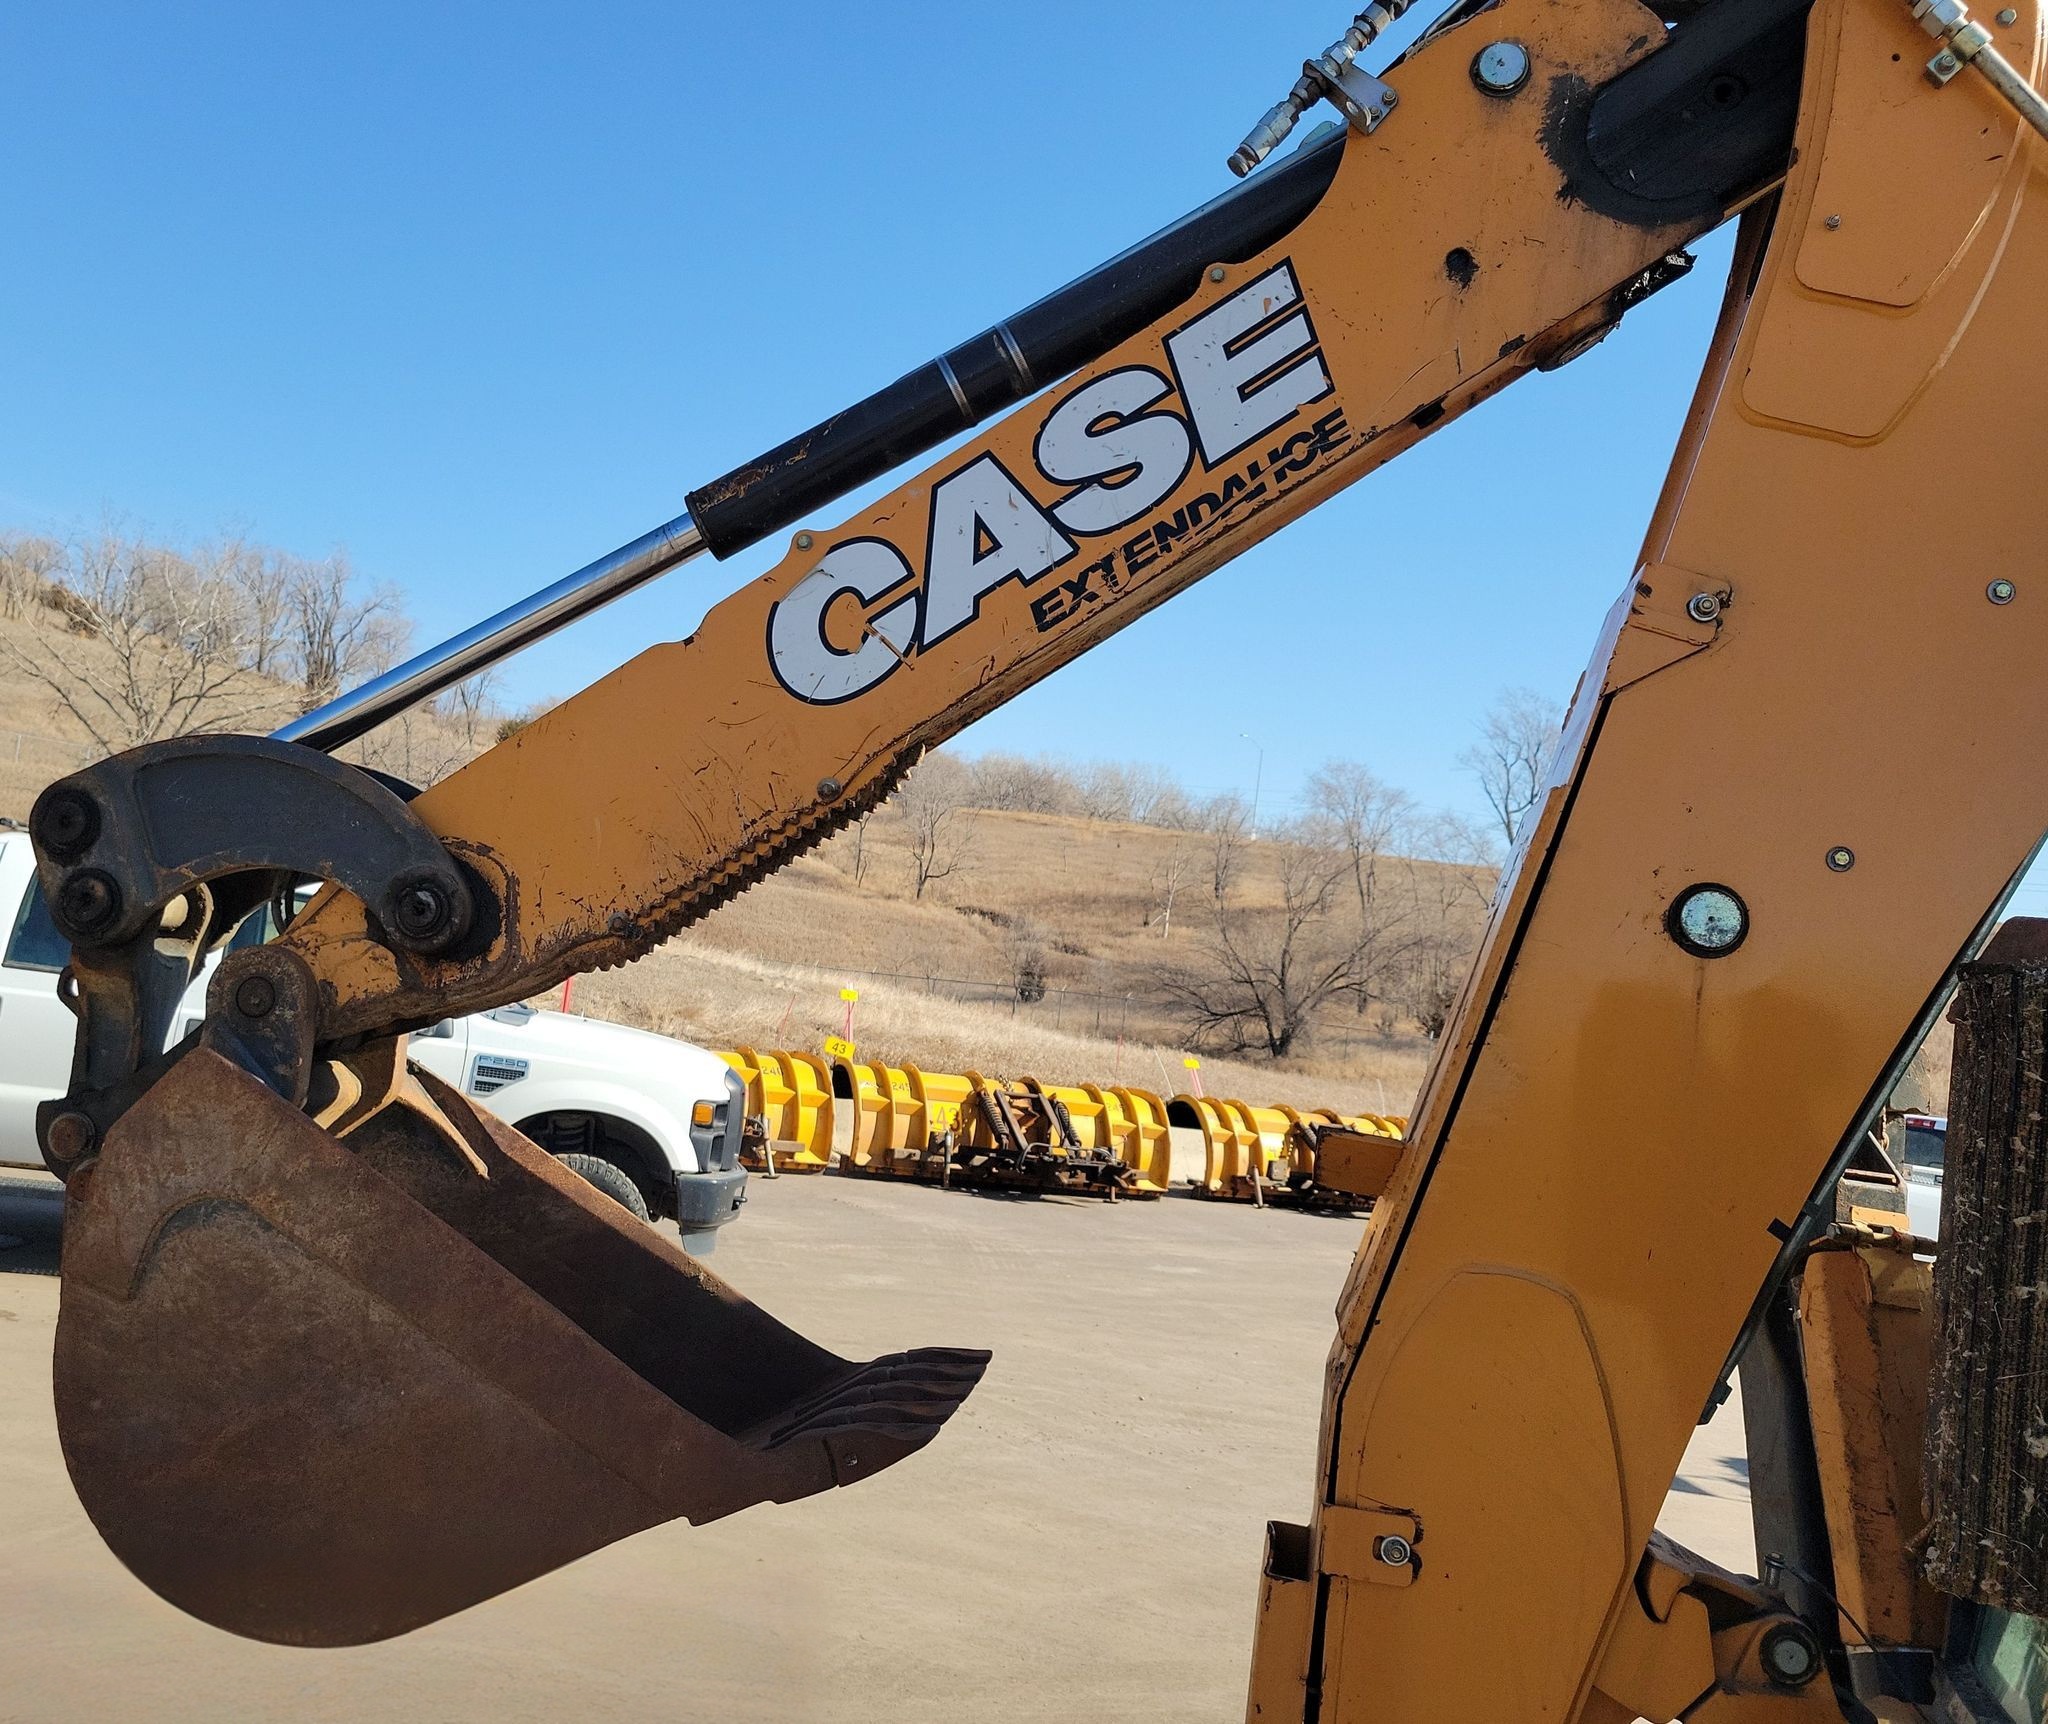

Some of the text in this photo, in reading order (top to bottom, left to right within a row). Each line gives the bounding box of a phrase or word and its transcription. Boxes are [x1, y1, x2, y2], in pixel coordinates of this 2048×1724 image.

[766, 256, 1336, 707] CASE
[1029, 407, 1352, 633] EXTENDAHOE
[479, 1055, 528, 1068] F-250
[832, 1042, 847, 1055] 43
[936, 1105, 961, 1132] 43
